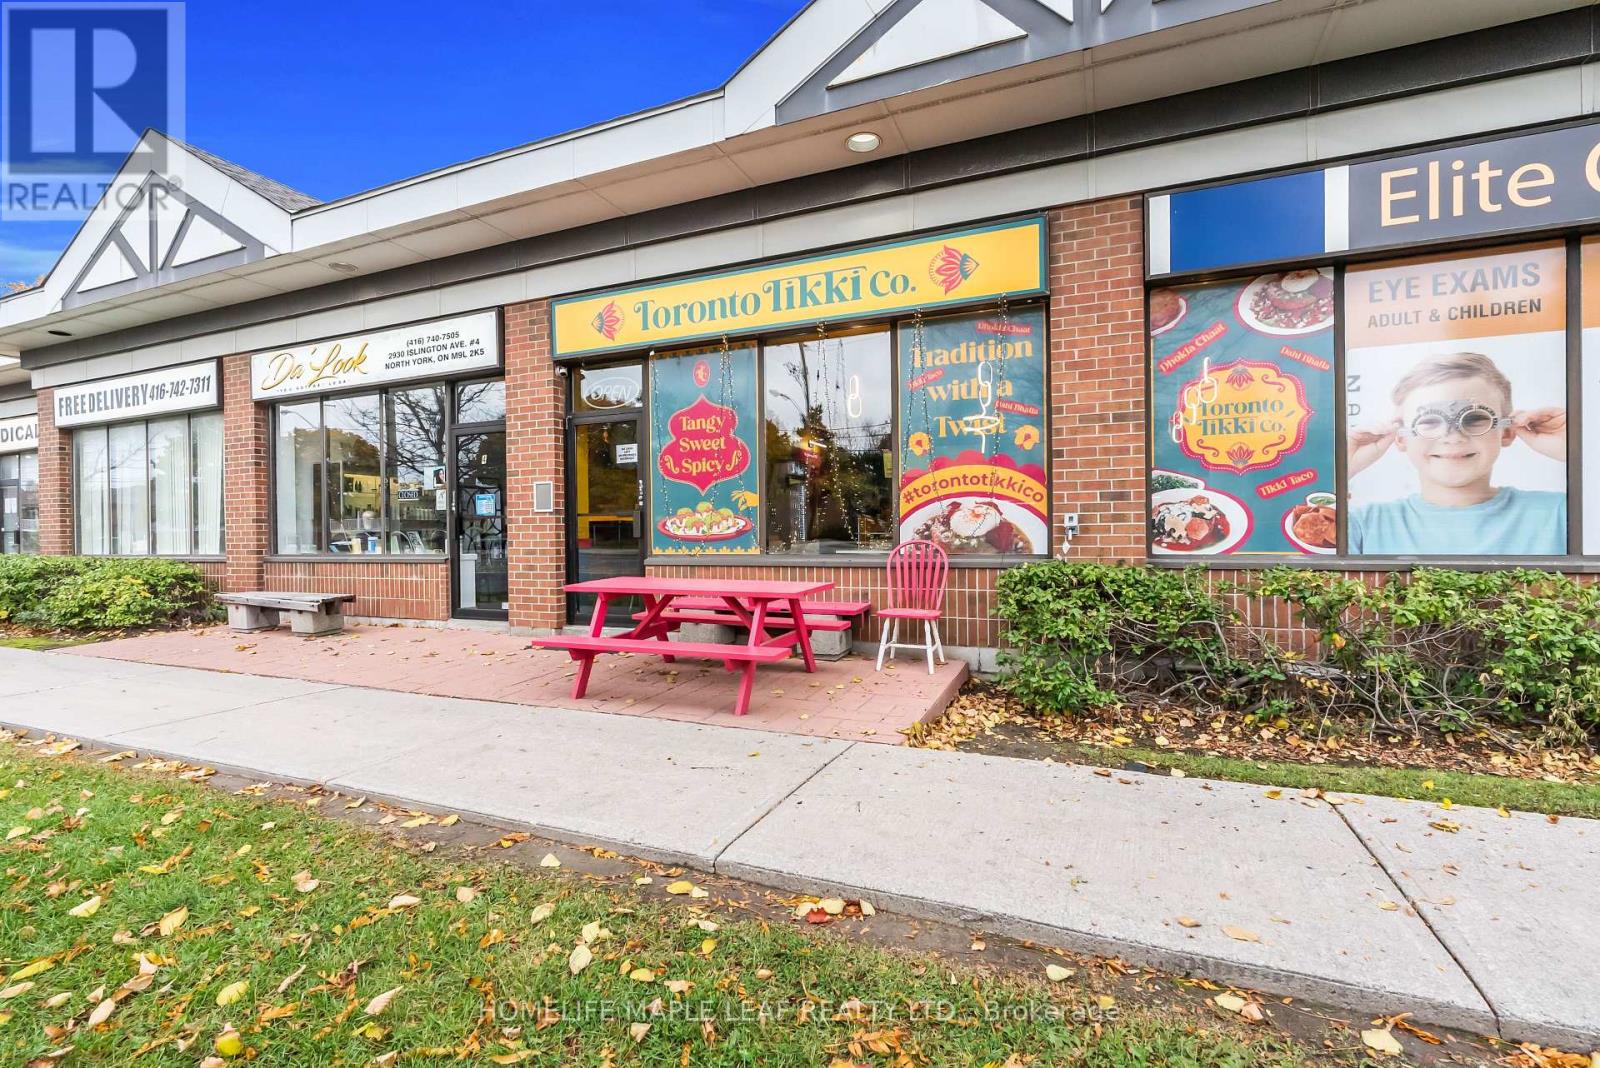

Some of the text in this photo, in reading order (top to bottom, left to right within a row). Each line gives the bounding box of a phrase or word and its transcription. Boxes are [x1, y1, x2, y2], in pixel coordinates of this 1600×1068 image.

[1379, 158, 1556, 228] Elite
[1368, 262, 1541, 304] EYE EXAMS
[633, 265, 917, 332] Toronto Tikki Co.
[1367, 298, 1542, 329] ADULT & CHILDREN
[406, 330, 460, 347] (416) 740-7505
[384, 348, 485, 370] NORTH YORK, ON M9L 2K5
[388, 350, 405, 360] 2930
[406, 343, 448, 357] ISLINGTON
[449, 340, 467, 350] AVE.
[58, 374, 212, 417] FREE DELIVERY 416-742-7311
[591, 384, 633, 401] OPEN
[927, 377, 988, 402] with
[996, 379, 1013, 398] a
[1200, 397, 1285, 418] Toronto
[679, 415, 725, 434] Tangy
[1198, 416, 1287, 436] Tikki Co.
[679, 436, 727, 453] Sweet
[681, 456, 725, 477] Spicy
[902, 472, 1045, 505] #torontotikkico
